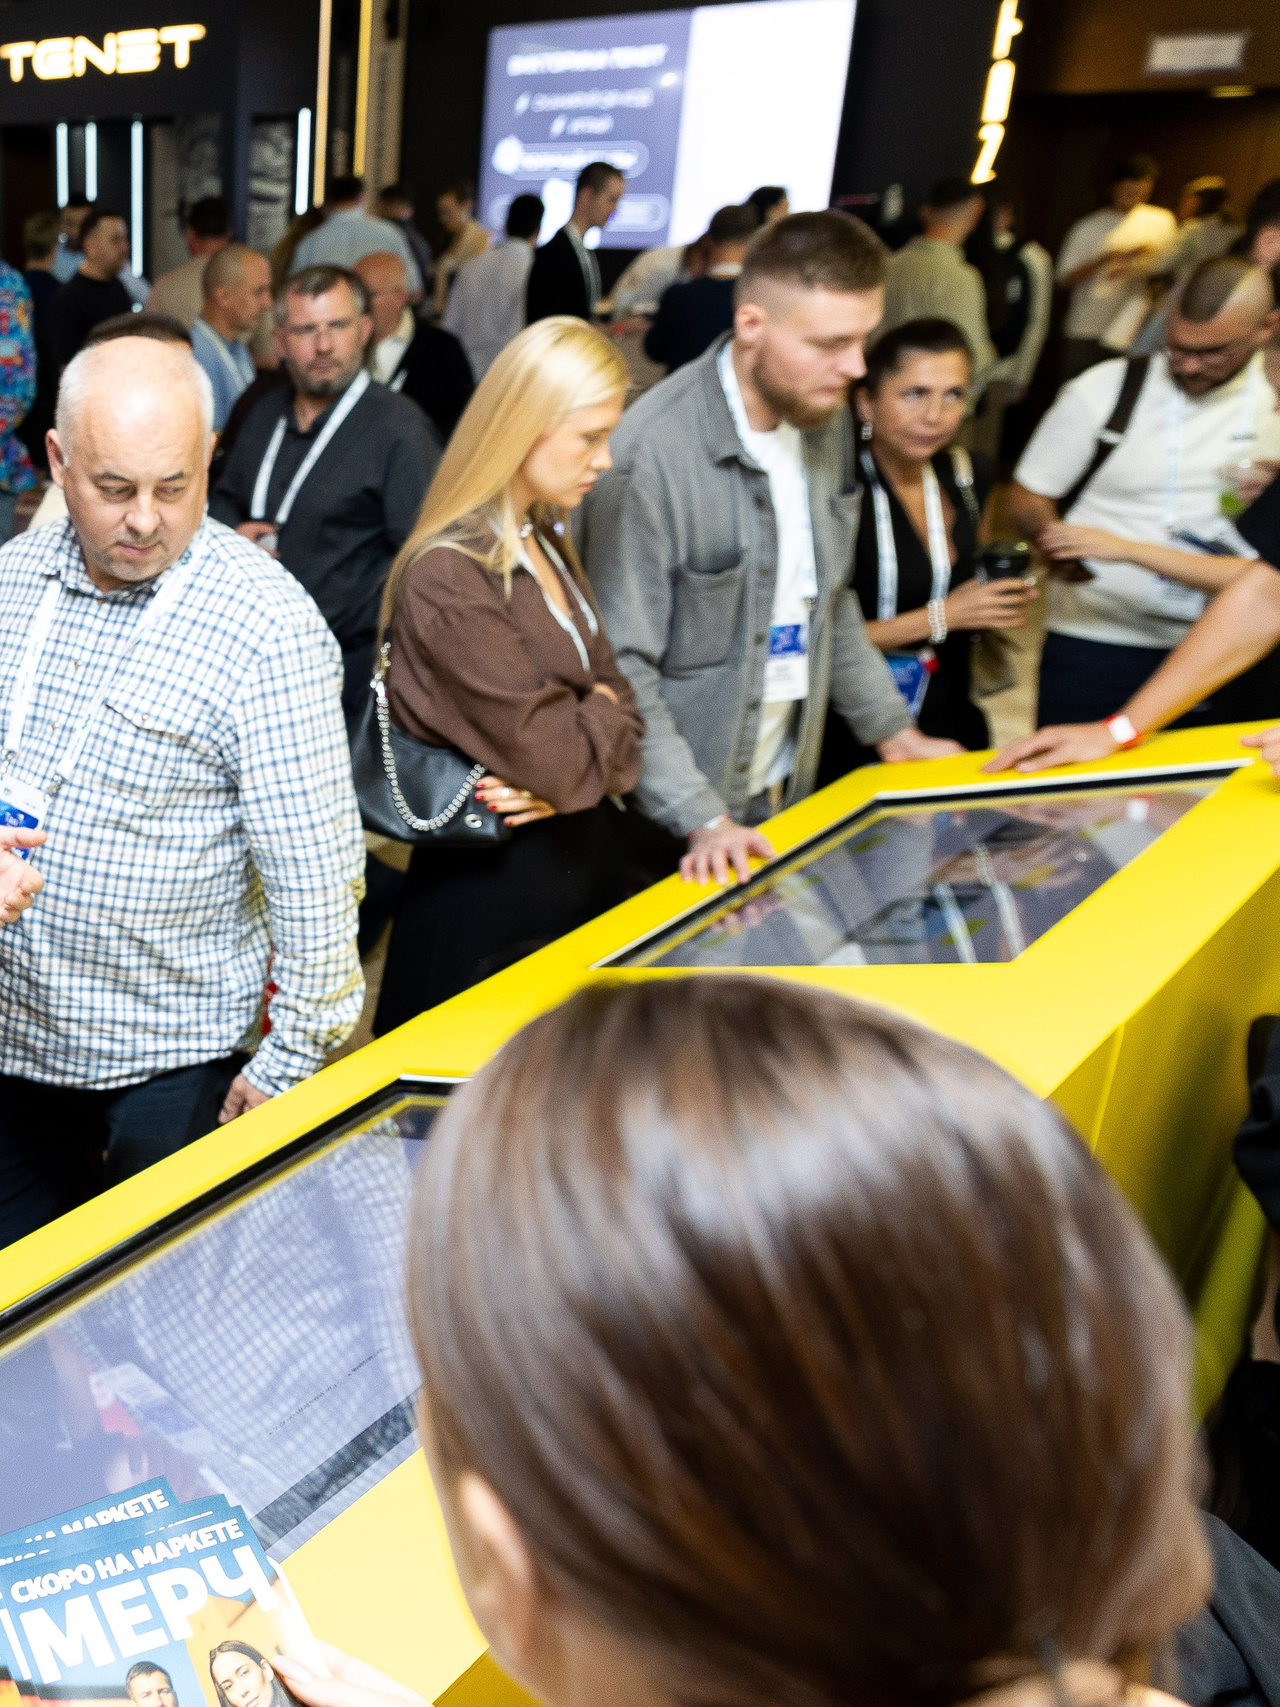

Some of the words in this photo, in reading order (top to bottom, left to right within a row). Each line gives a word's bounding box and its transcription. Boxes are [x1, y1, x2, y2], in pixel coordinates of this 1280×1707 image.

[10, 1564, 96, 1604] СКОРО
[94, 1552, 136, 1580] НА
[131, 1517, 245, 1569] МАРКЕТЕ
[19, 1544, 282, 1685] МЕРЧ
